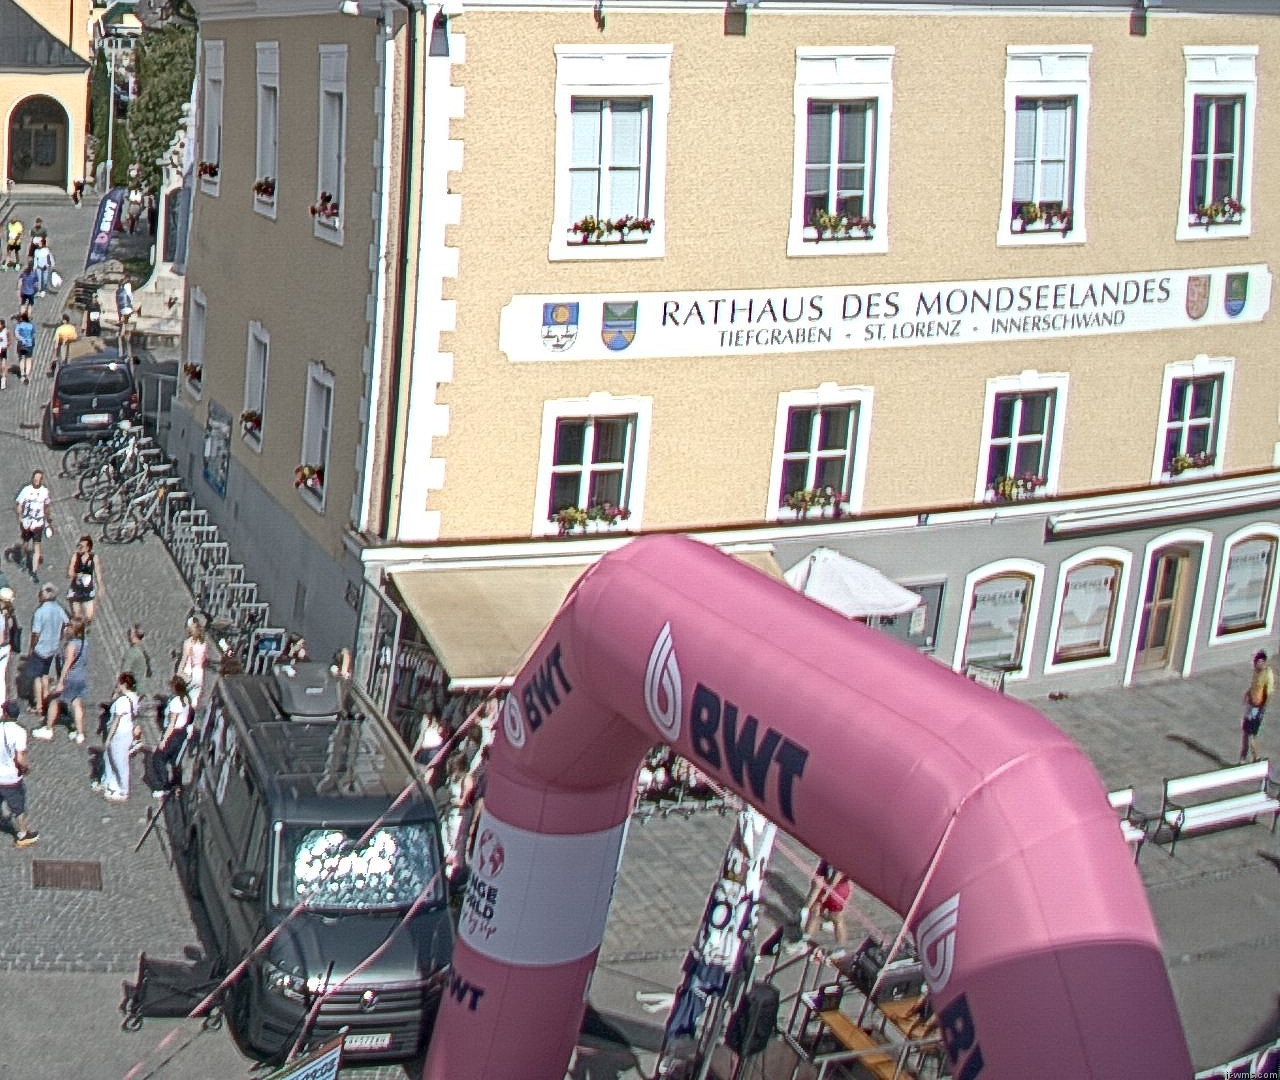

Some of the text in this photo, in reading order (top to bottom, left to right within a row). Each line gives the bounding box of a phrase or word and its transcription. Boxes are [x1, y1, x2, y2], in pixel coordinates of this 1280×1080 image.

[662, 277, 1171, 326] RATHAUS DES MONDSEELANDES
[719, 309, 1126, 347] TIEFGRABEN ST. LORENZ INNERSCHWAND
[523, 642, 572, 731] BWT
[691, 682, 809, 825] BWT
[449, 970, 485, 1011] WT
